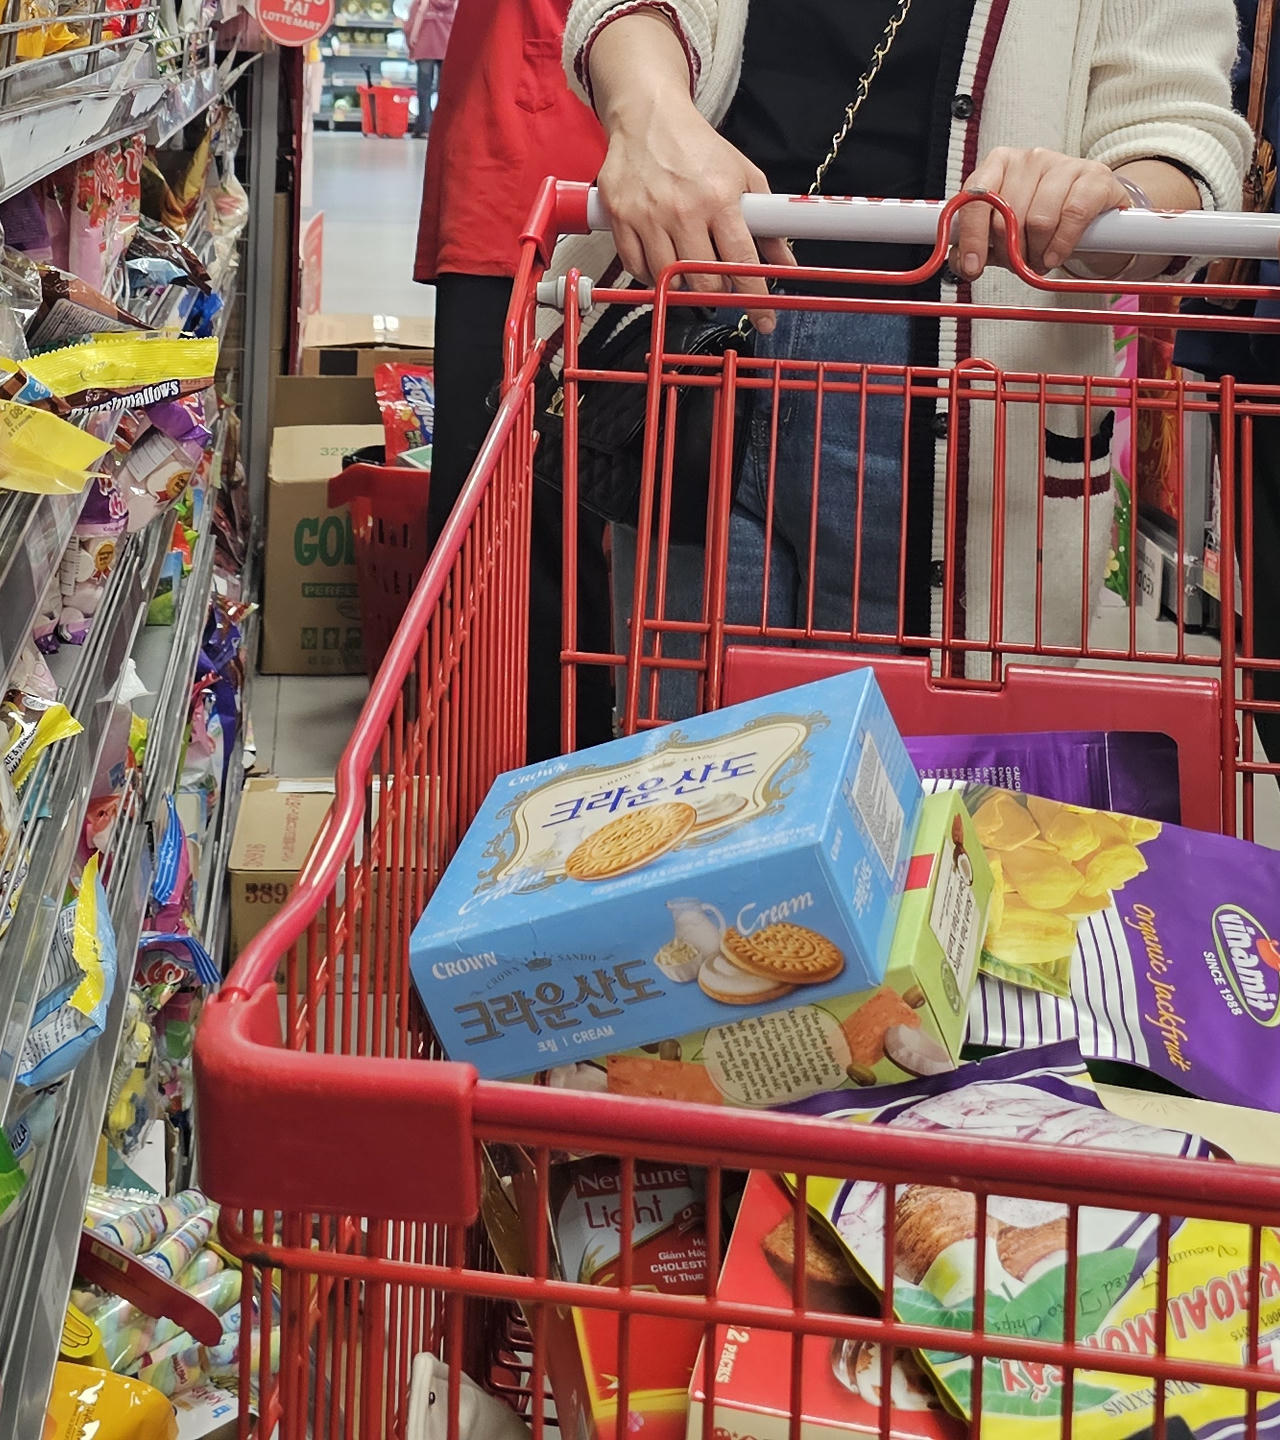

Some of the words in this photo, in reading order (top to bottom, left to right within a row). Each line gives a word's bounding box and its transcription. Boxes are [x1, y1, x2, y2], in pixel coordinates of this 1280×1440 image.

[507, 761, 570, 788] CROWN
[541, 750, 759, 829] 크라운산도
[735, 891, 816, 937] Cream
[430, 951, 498, 981] CROWN
[1203, 950, 1227, 986] SINCE
[1219, 985, 1244, 1016] 1988
[453, 959, 667, 1045] 크라운산도
[1144, 971, 1192, 1072] Jackfruit
[572, 1025, 616, 1045] CREAM
